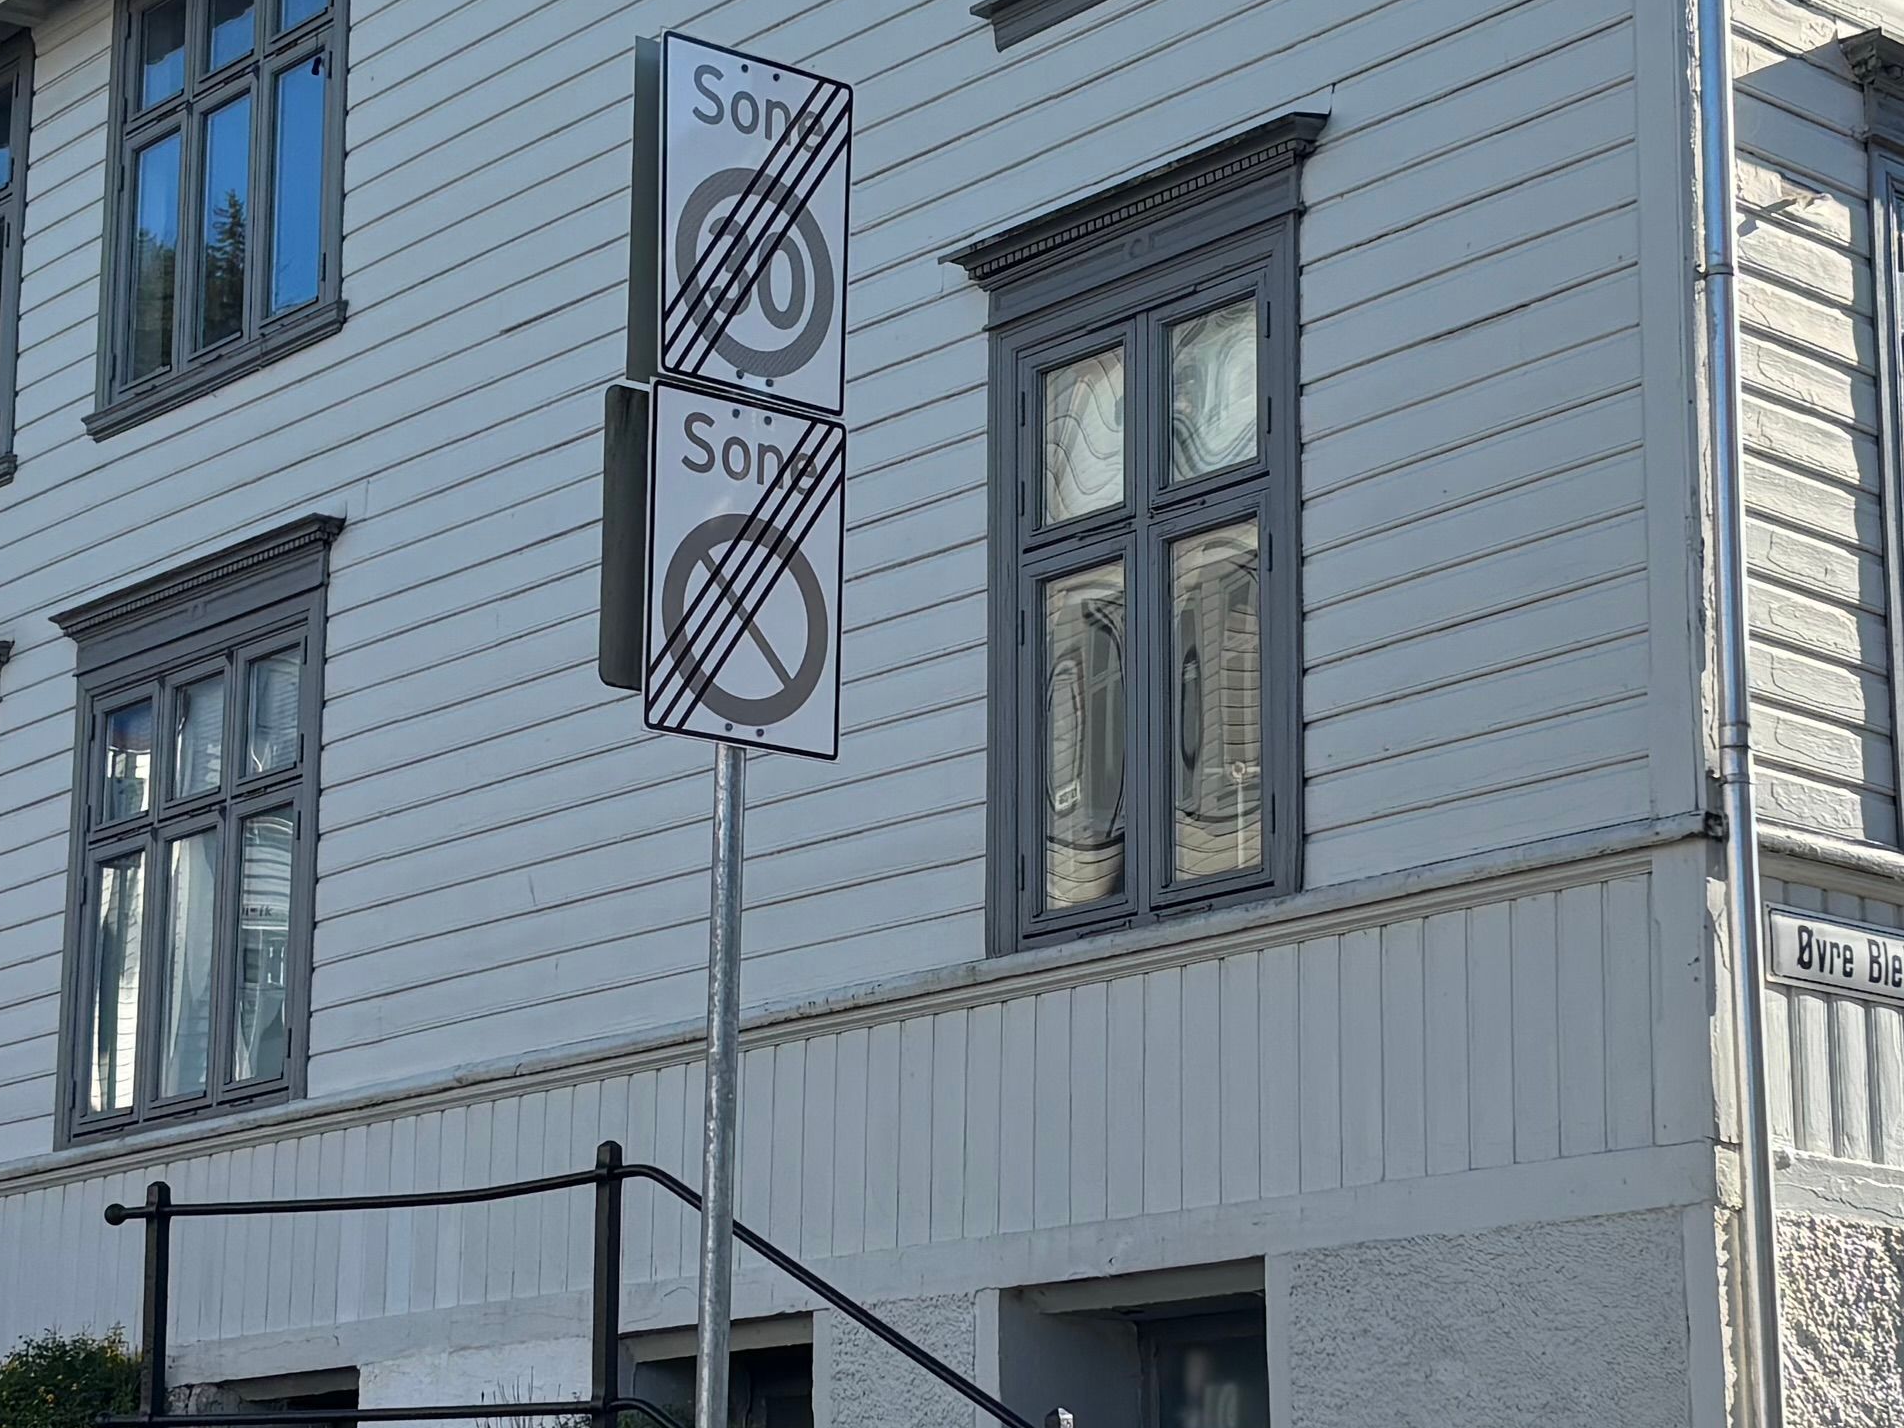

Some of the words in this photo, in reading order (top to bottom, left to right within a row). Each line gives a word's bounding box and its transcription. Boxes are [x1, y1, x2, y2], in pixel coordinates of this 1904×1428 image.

[693, 64, 825, 153] Sone
[708, 215, 806, 330] 30
[682, 412, 819, 496] Sone
[1797, 925, 1854, 978] Øvre
